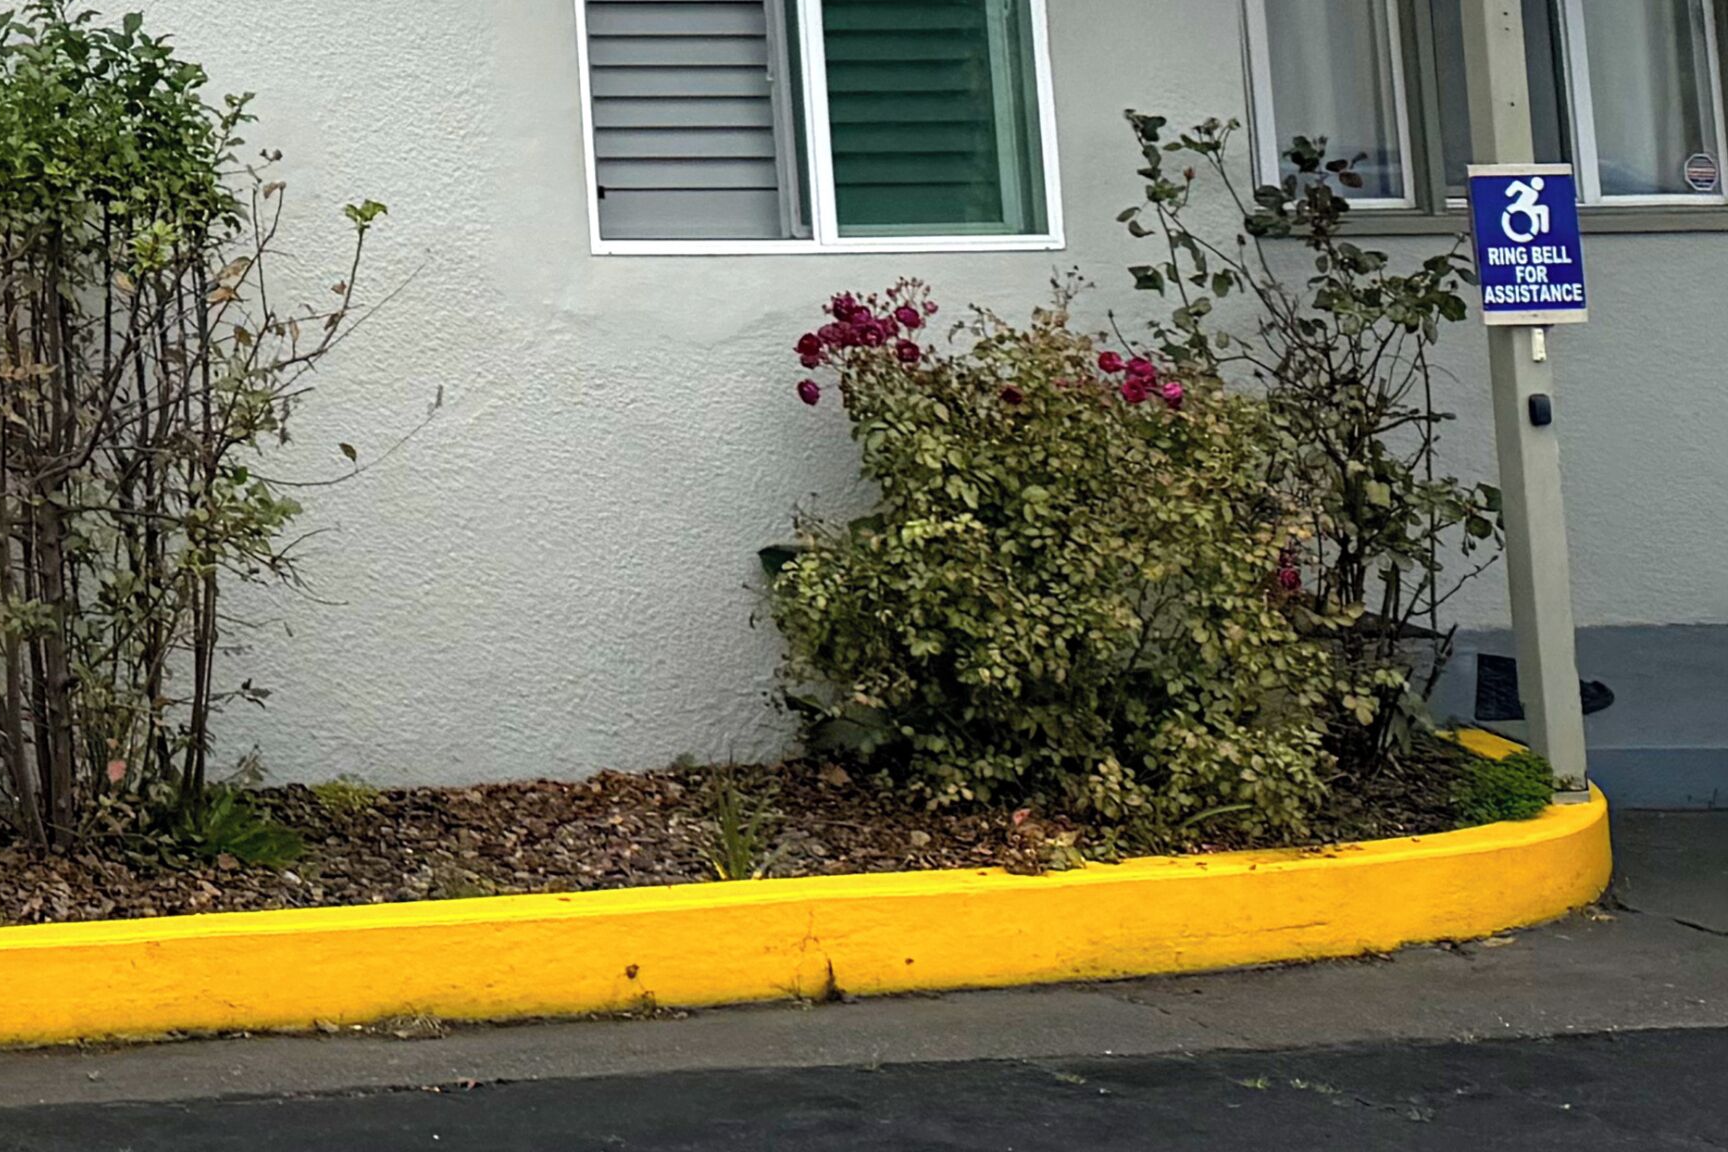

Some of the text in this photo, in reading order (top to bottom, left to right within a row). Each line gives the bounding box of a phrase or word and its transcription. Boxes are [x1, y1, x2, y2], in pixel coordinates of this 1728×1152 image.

[1488, 245, 1572, 266] RING BELL
[1515, 265, 1548, 284] FOR
[1484, 283, 1584, 304] ASSISTANCE
